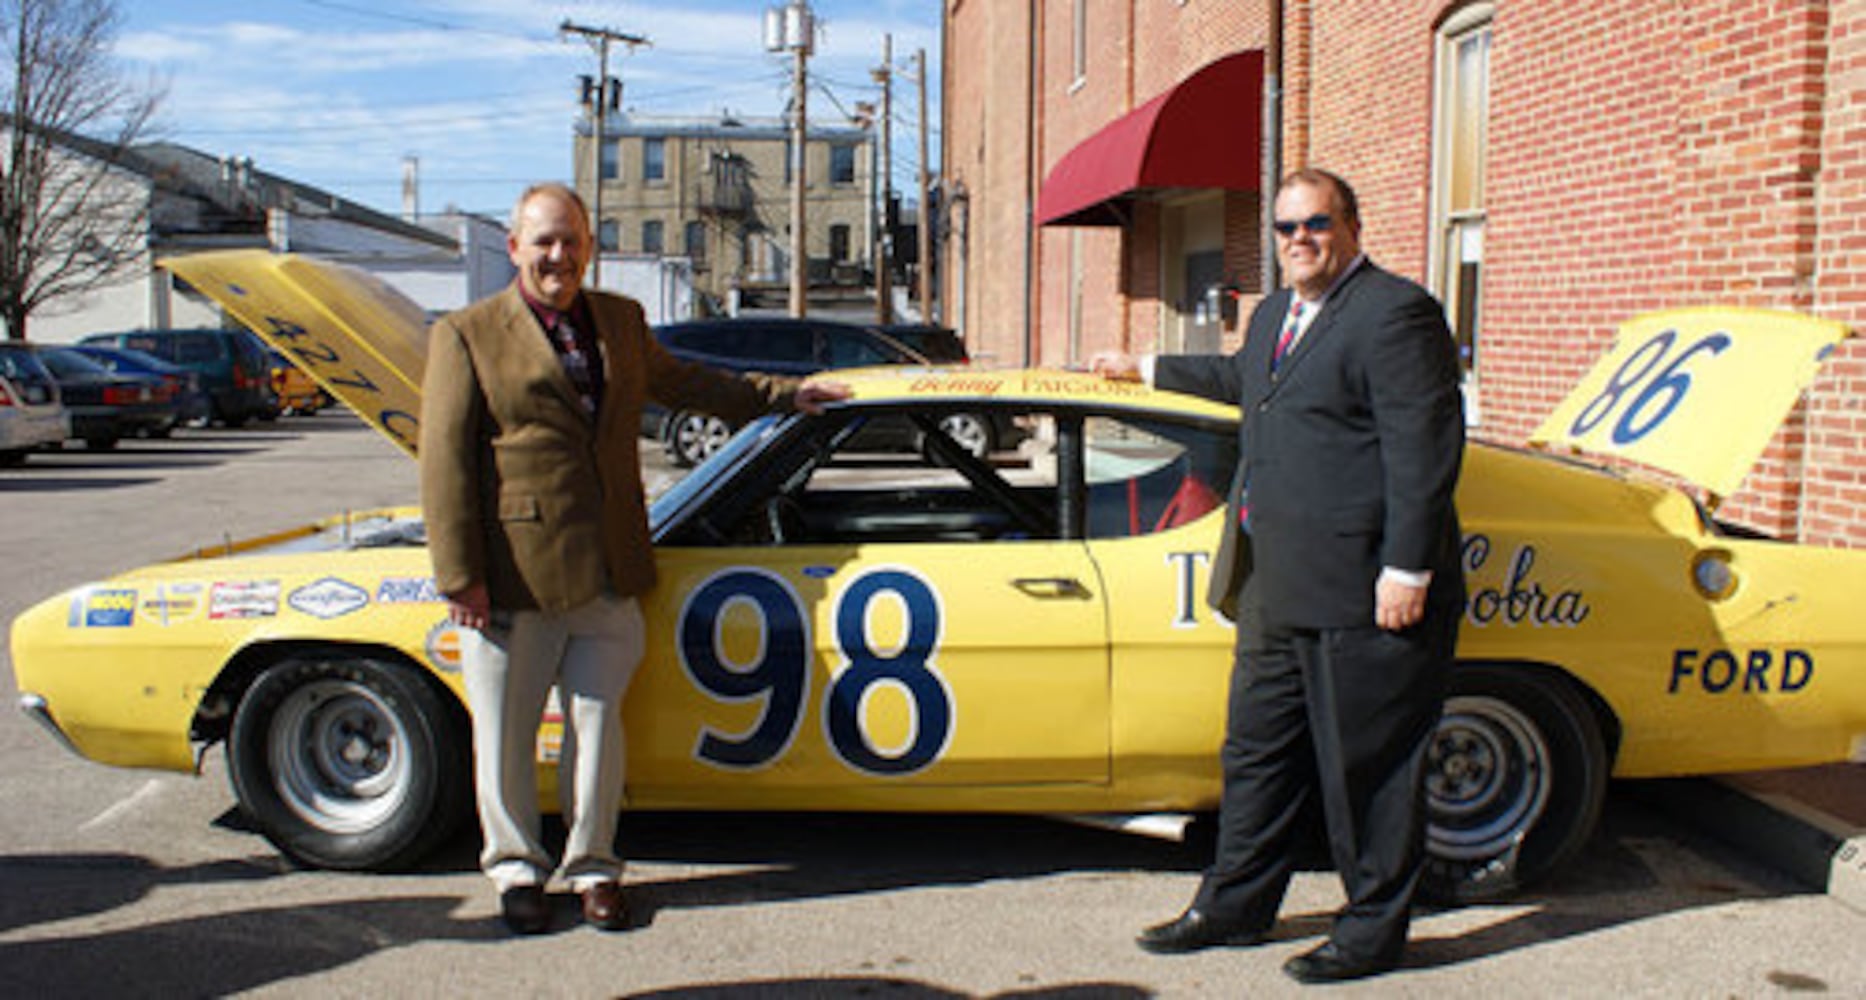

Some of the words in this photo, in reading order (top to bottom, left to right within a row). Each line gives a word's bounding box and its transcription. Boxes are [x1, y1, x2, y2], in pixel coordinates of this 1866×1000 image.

[264, 315, 382, 394] 427
[677, 565, 956, 777] 98
[1668, 648, 1816, 695] FORD
